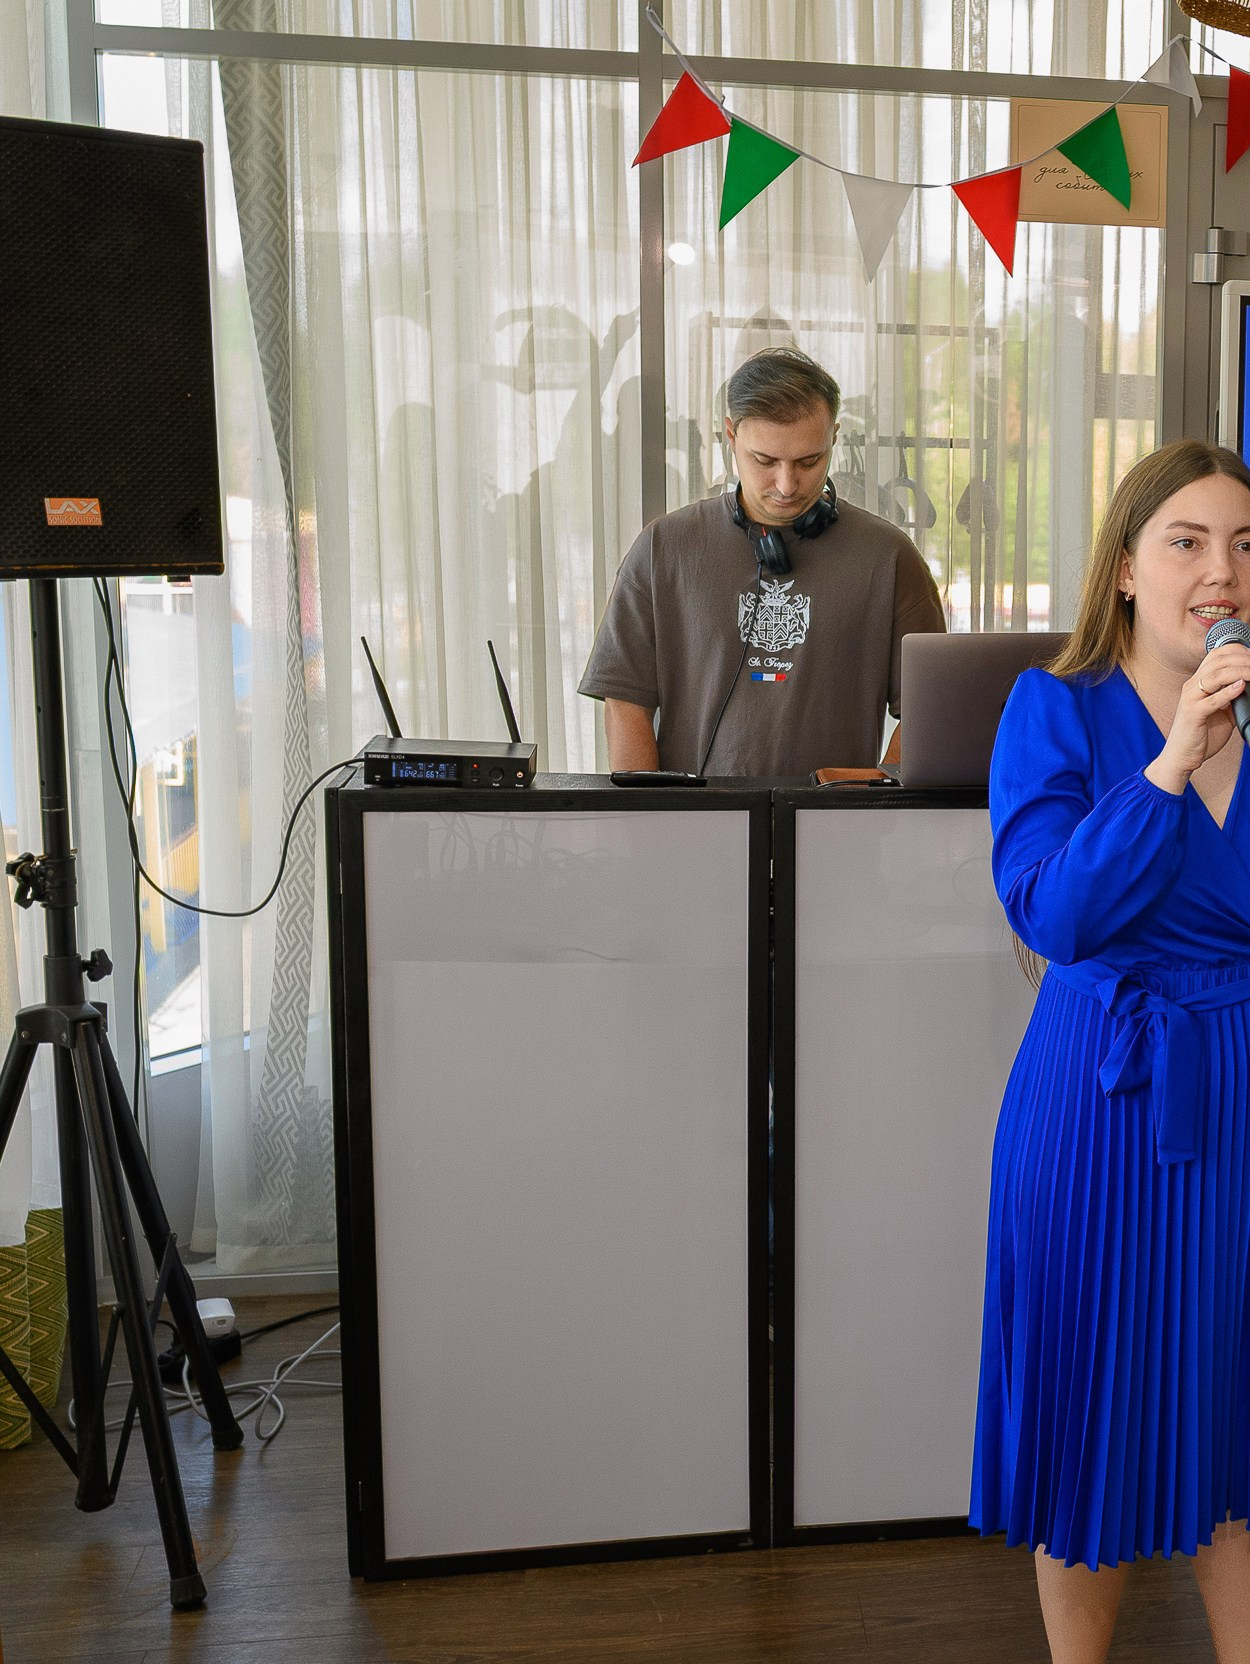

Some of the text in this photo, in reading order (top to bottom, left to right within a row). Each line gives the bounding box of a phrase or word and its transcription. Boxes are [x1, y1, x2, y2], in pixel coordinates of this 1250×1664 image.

[1034, 167, 1069, 183] для
[1056, 175, 1105, 191] событ
[44, 498, 100, 514] LAX
[48, 516, 102, 525] SONIC SOLUTION
